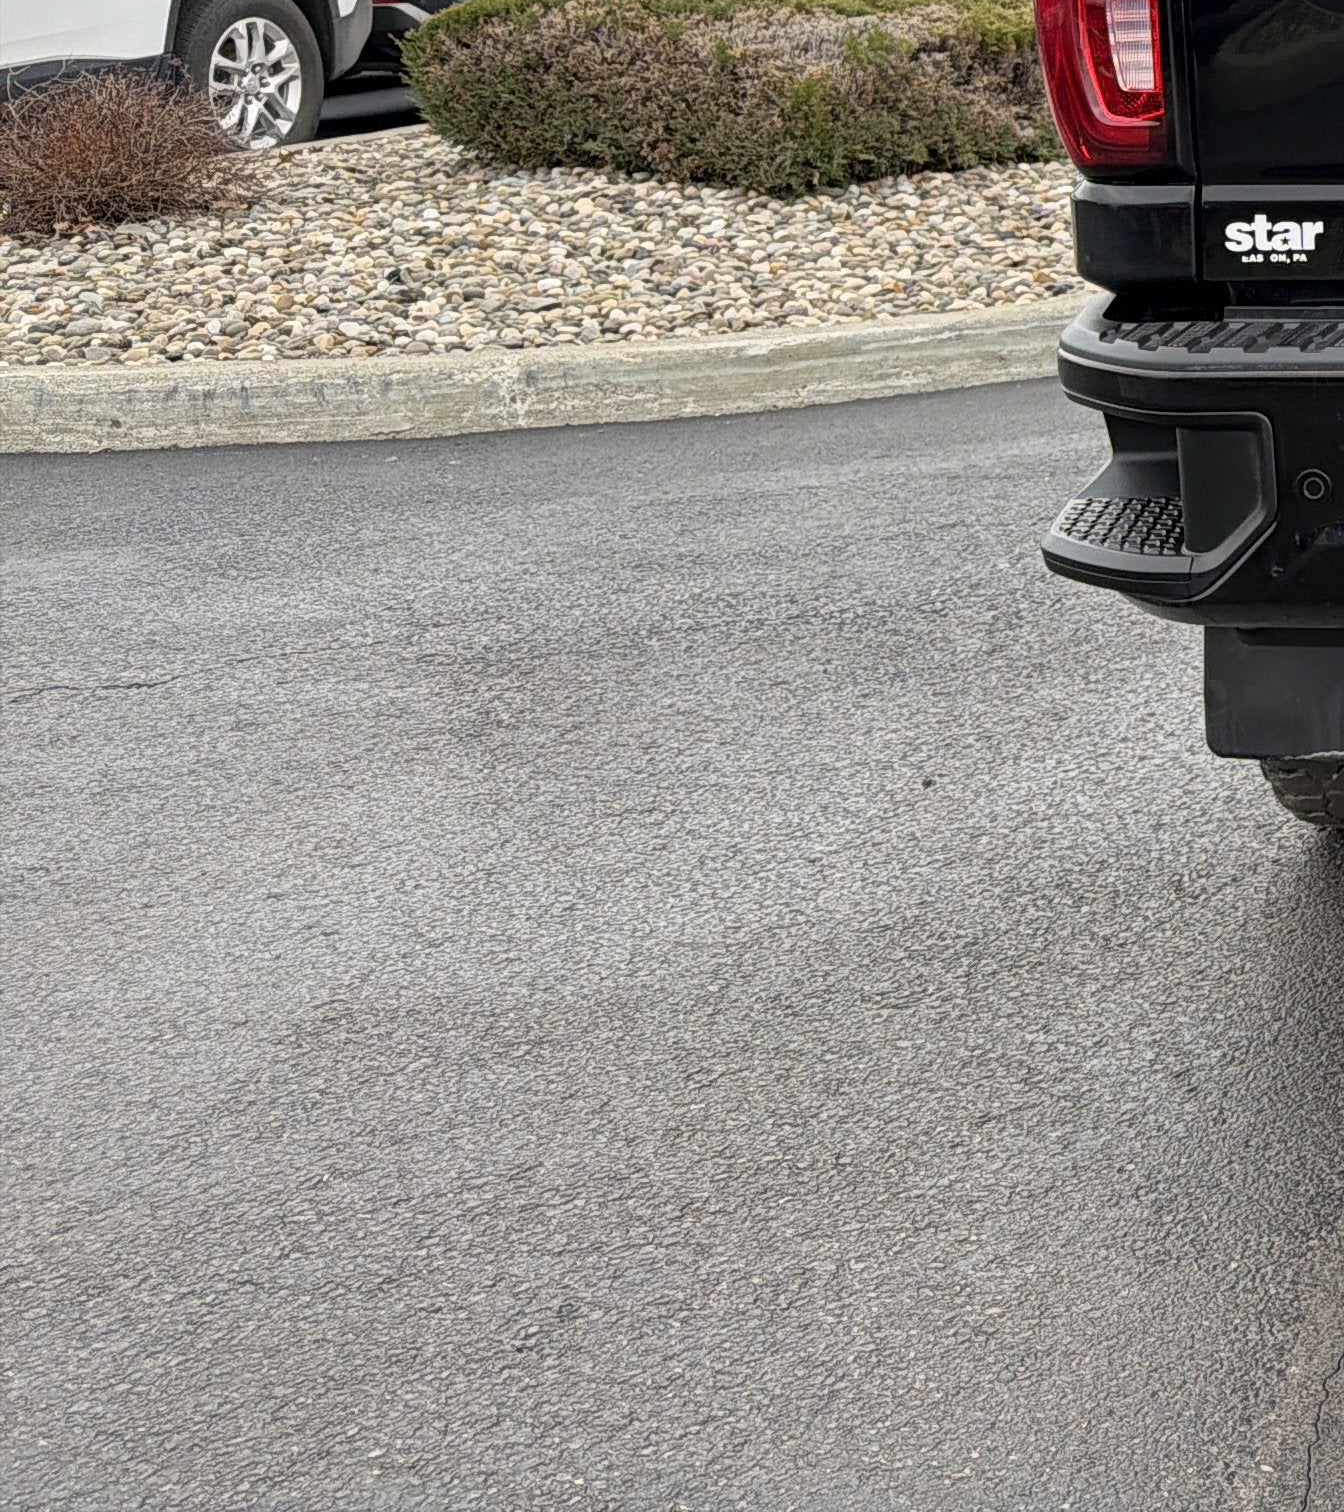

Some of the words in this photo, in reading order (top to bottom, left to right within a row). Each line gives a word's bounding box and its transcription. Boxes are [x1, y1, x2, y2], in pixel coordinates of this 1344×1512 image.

[1224, 214, 1324, 252] star
[1241, 253, 1291, 264] EASON,
[1293, 253, 1308, 263] PA
